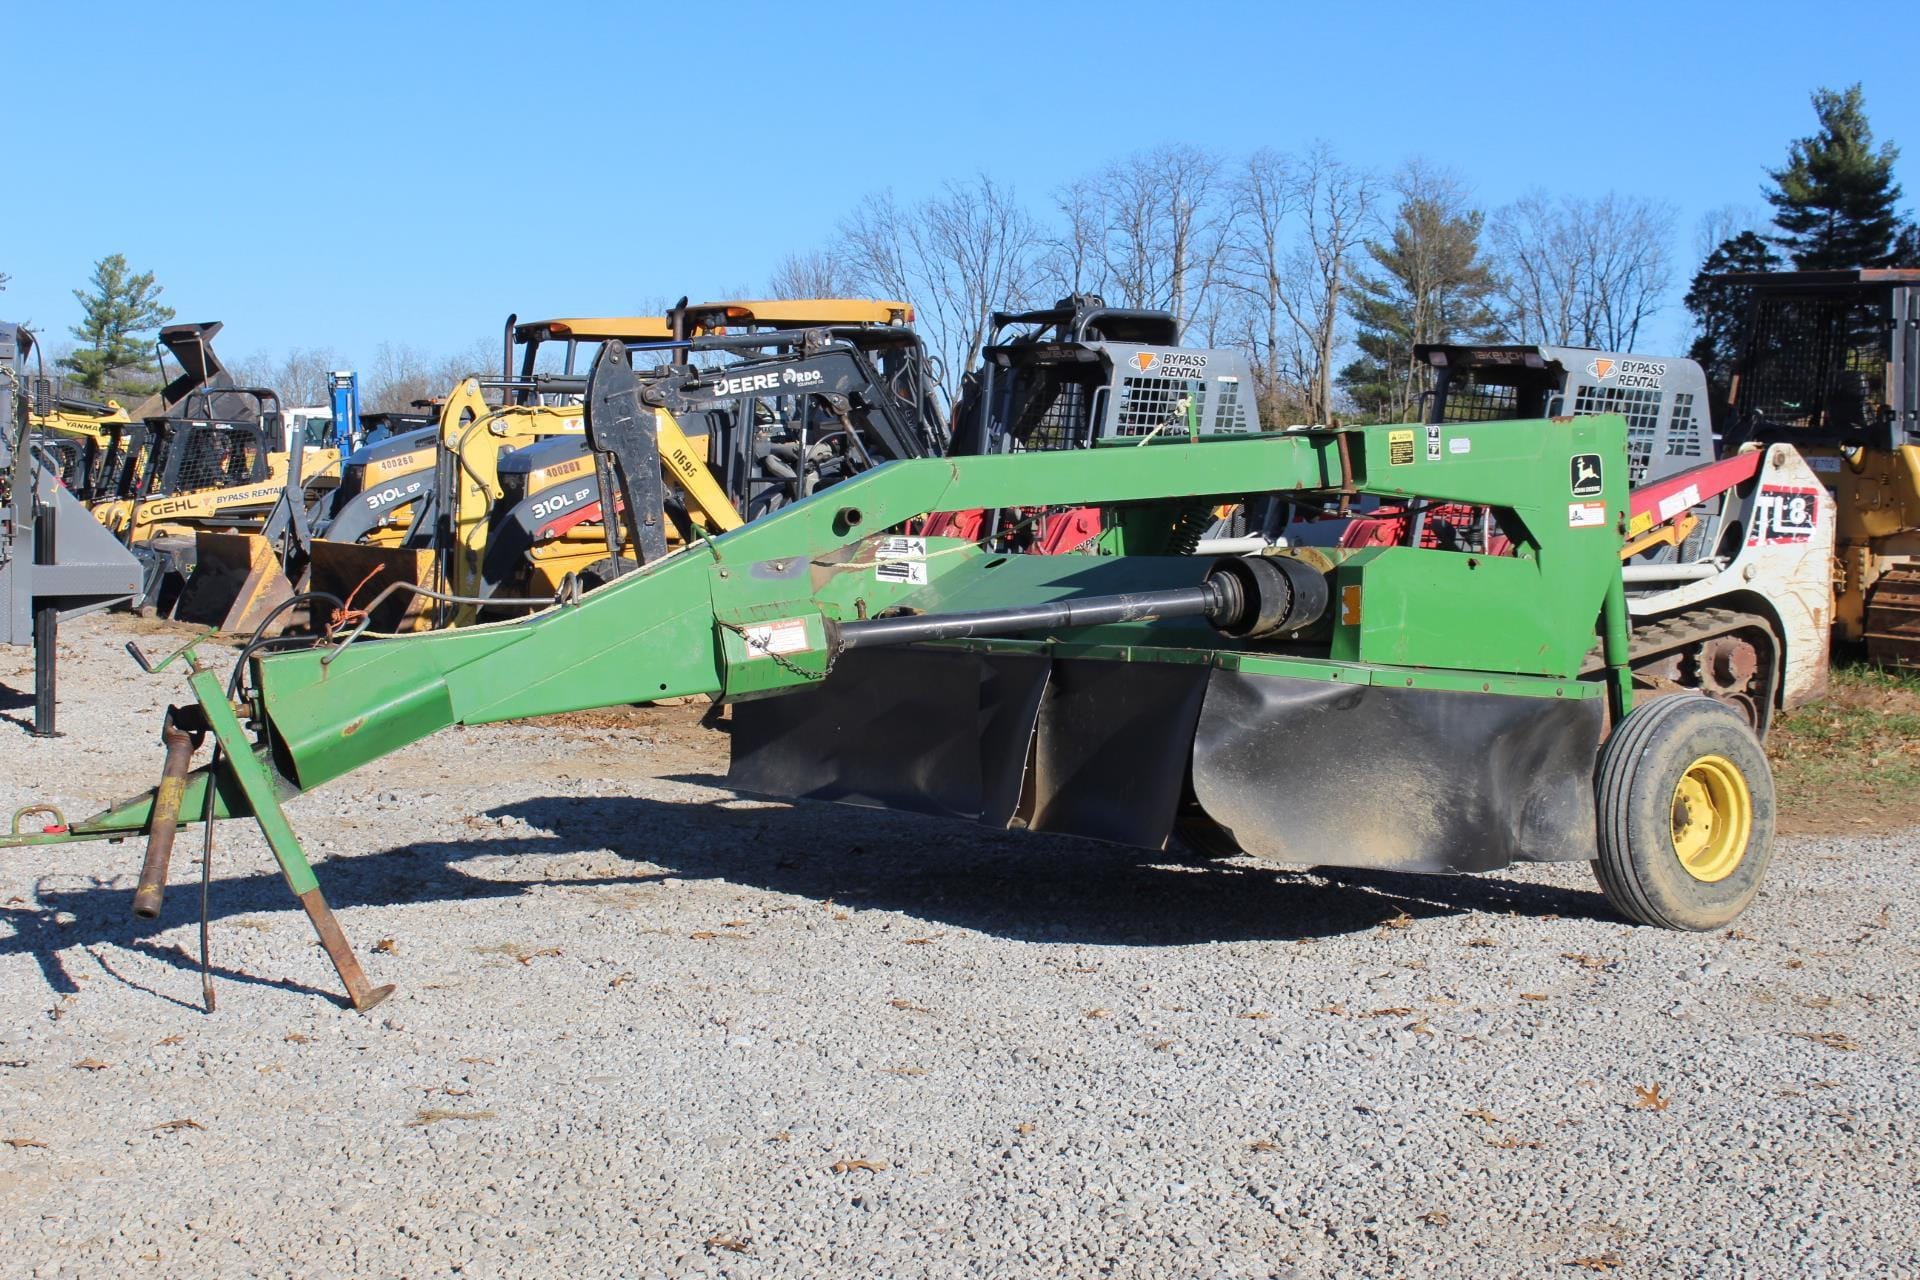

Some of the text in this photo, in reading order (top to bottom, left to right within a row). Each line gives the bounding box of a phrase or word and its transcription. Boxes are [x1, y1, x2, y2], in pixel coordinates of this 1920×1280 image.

[1163, 353, 1207, 367] BYPASS
[1621, 361, 1666, 376] BYPASS
[713, 372, 780, 396] DEERE
[1160, 366, 1203, 379] RENTAL
[1617, 374, 1661, 389] RENTAL
[66, 421, 99, 432] YANMA
[673, 449, 697, 477] 0695
[150, 499, 199, 516] GEHL
[216, 491, 249, 504] BYPASS
[366, 482, 421, 509] 310L EP
[531, 488, 590, 519] 310L EP
[1752, 495, 1816, 546] TL8
